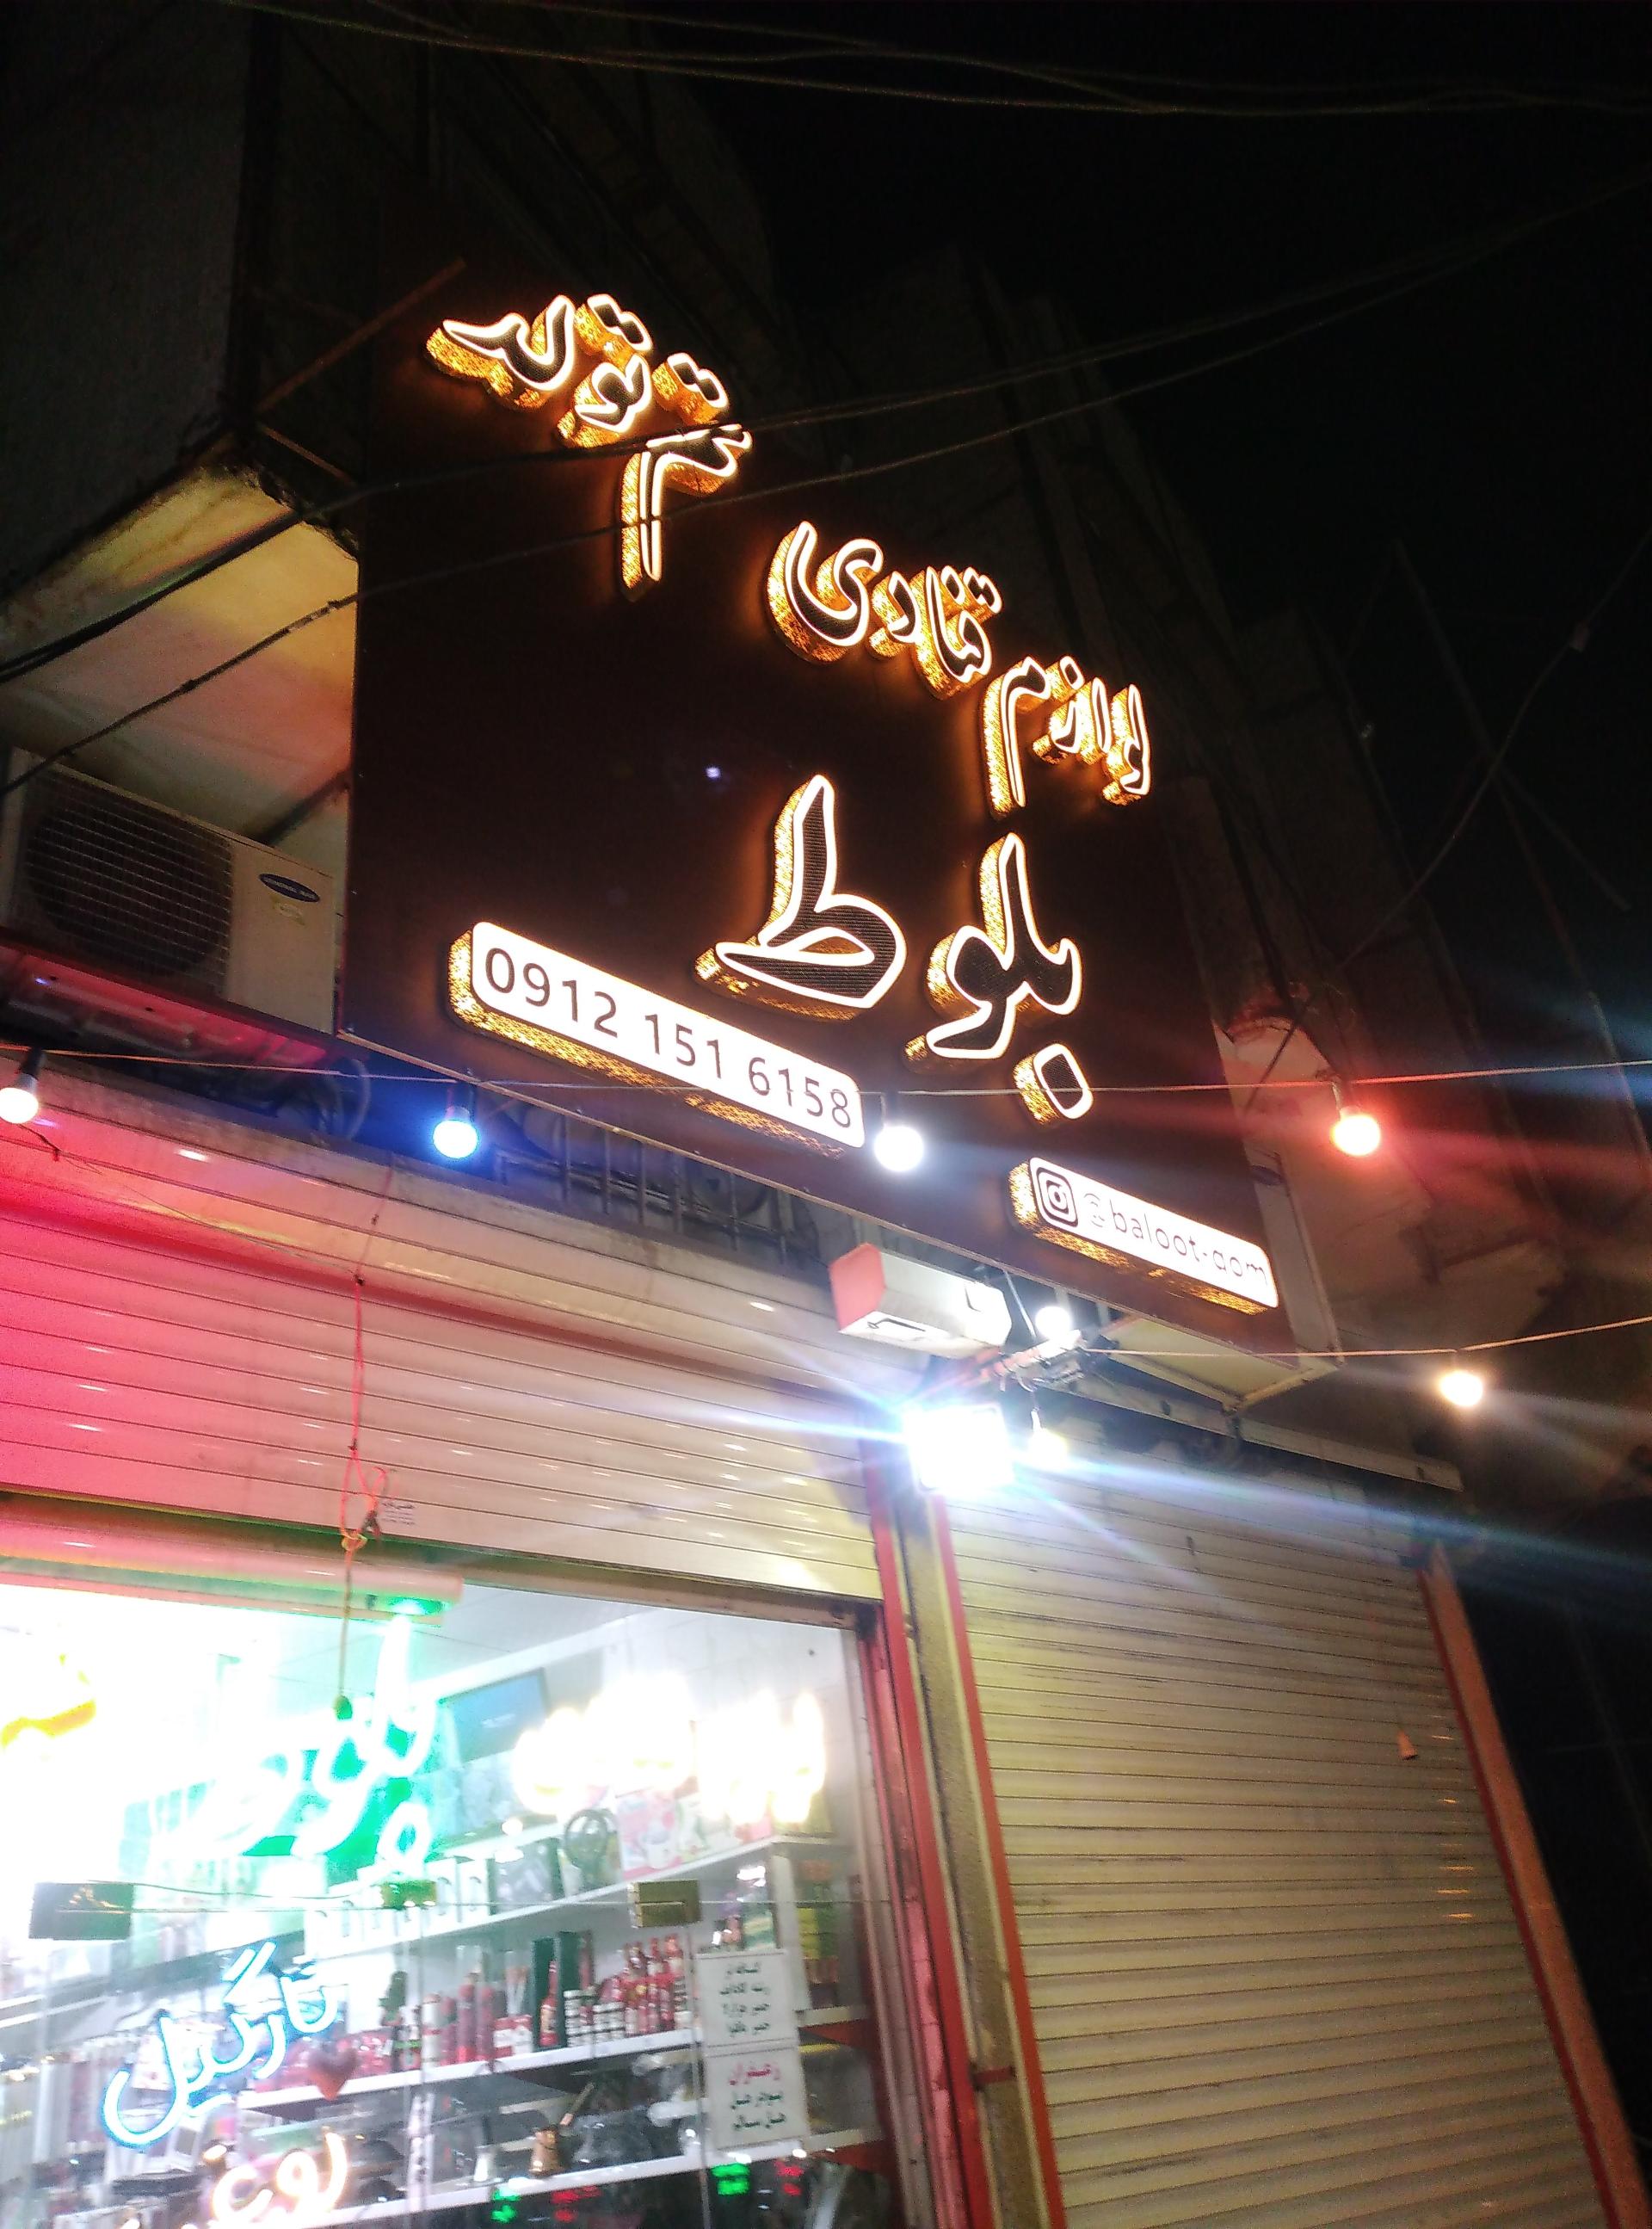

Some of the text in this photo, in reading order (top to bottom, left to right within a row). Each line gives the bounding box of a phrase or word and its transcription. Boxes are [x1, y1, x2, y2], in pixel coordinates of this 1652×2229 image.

[435, 293, 754, 583] تم تولد
[777, 519, 1152, 809] لوازم قنادی
[484, 946, 853, 1129] 0912 151 6158
[711, 773, 1095, 1121] بلوط
